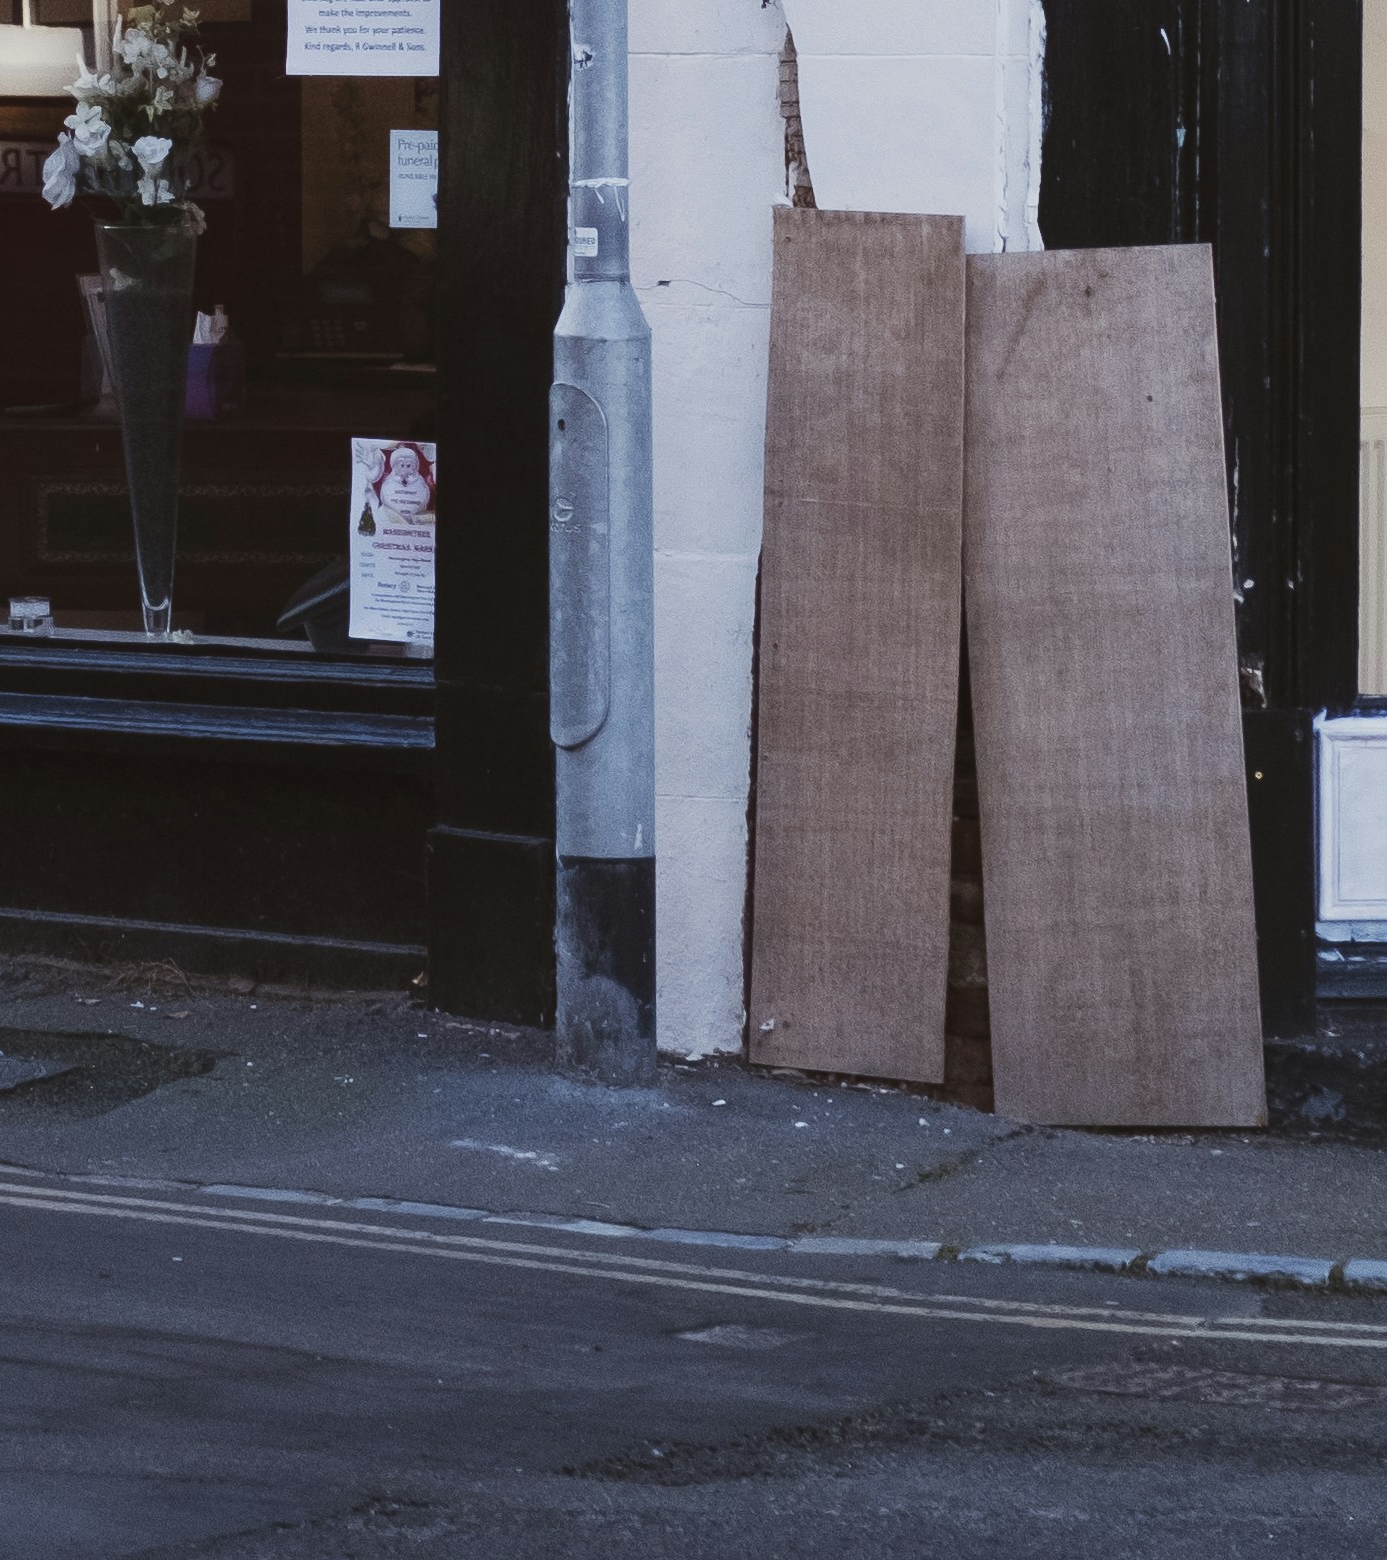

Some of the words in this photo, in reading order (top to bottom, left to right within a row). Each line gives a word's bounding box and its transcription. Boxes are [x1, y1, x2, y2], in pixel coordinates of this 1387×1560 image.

[341, 9, 354, 17] the
[319, 25, 341, 34] thank
[372, 28, 389, 36] your
[304, 41, 321, 51] Kind
